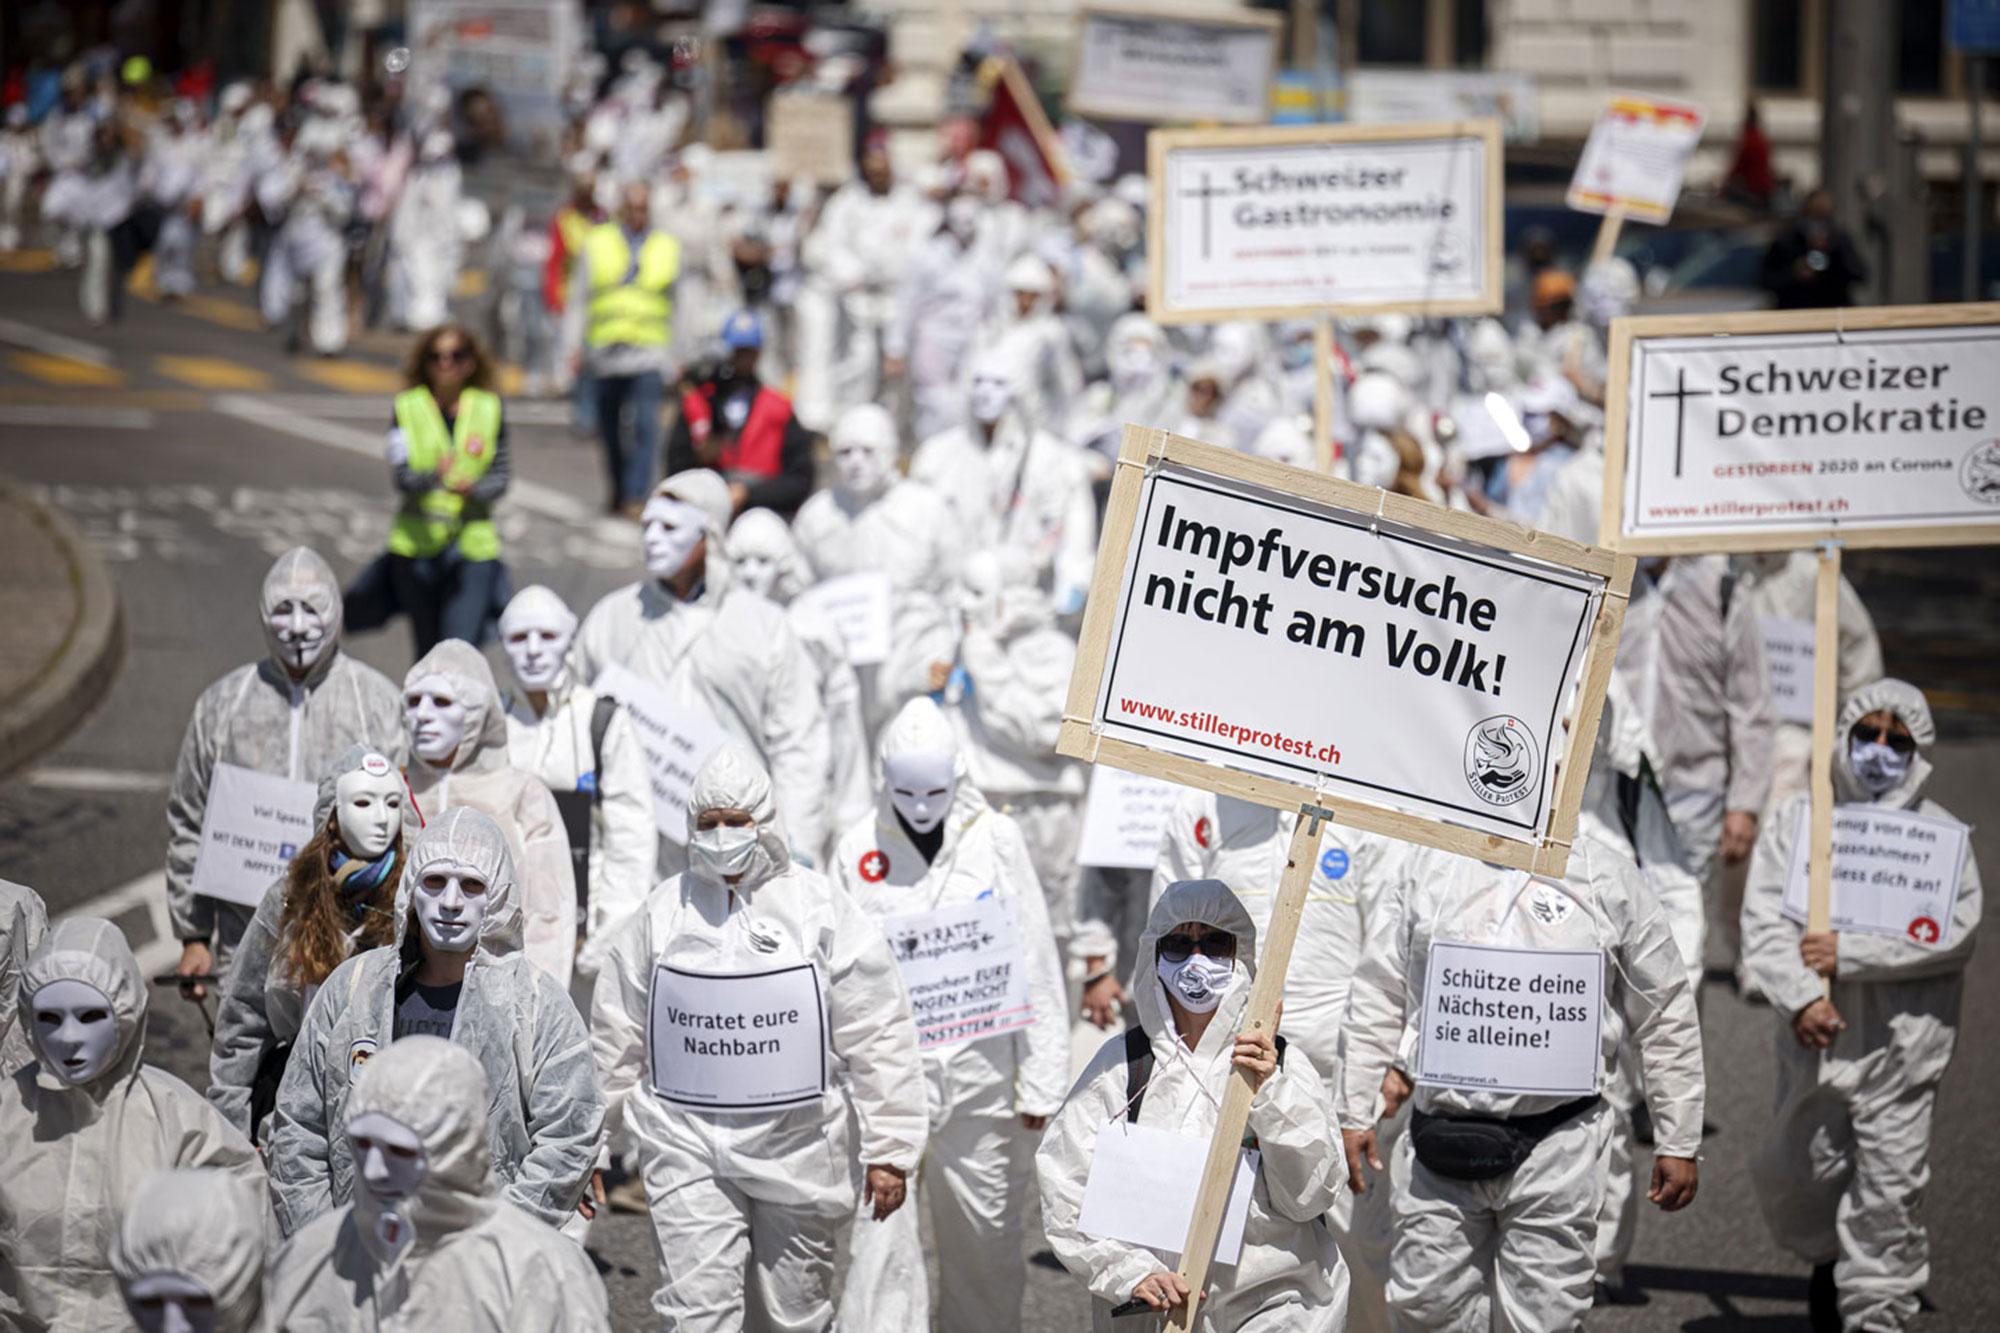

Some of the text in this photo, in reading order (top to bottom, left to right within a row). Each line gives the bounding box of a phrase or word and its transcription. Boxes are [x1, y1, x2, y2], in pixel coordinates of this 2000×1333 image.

[1233, 164, 1406, 193] Schweizer
[1233, 194, 1454, 228] Gastronomie
[1718, 359, 1949, 395] Schweizer
[1717, 399, 1987, 438] Demokratie
[1818, 459, 1859, 475] 2020
[1864, 461, 1886, 473] an
[1891, 458, 1954, 473] Corona
[1649, 499, 1850, 519] www.stillerprotest.ch
[1157, 503, 1497, 632] Impfversuche
[1143, 570, 1507, 696] nicht am Volk!
[1120, 697, 1342, 766] www.stillerprotest.ch
[232, 834, 255, 849] DEM
[1832, 818, 1937, 843] enug von den
[1832, 841, 1931, 865] assnahmen?
[1871, 870, 1908, 888] dich
[1912, 879, 1942, 894] an!
[1442, 968, 1587, 995] Schütze deine
[667, 1006, 799, 1030] Verratet eure
[1438, 994, 1588, 1025] Nächsten, lass
[684, 1036, 781, 1057] Nachbarn
[1435, 1021, 1551, 1049] sie alleine!
